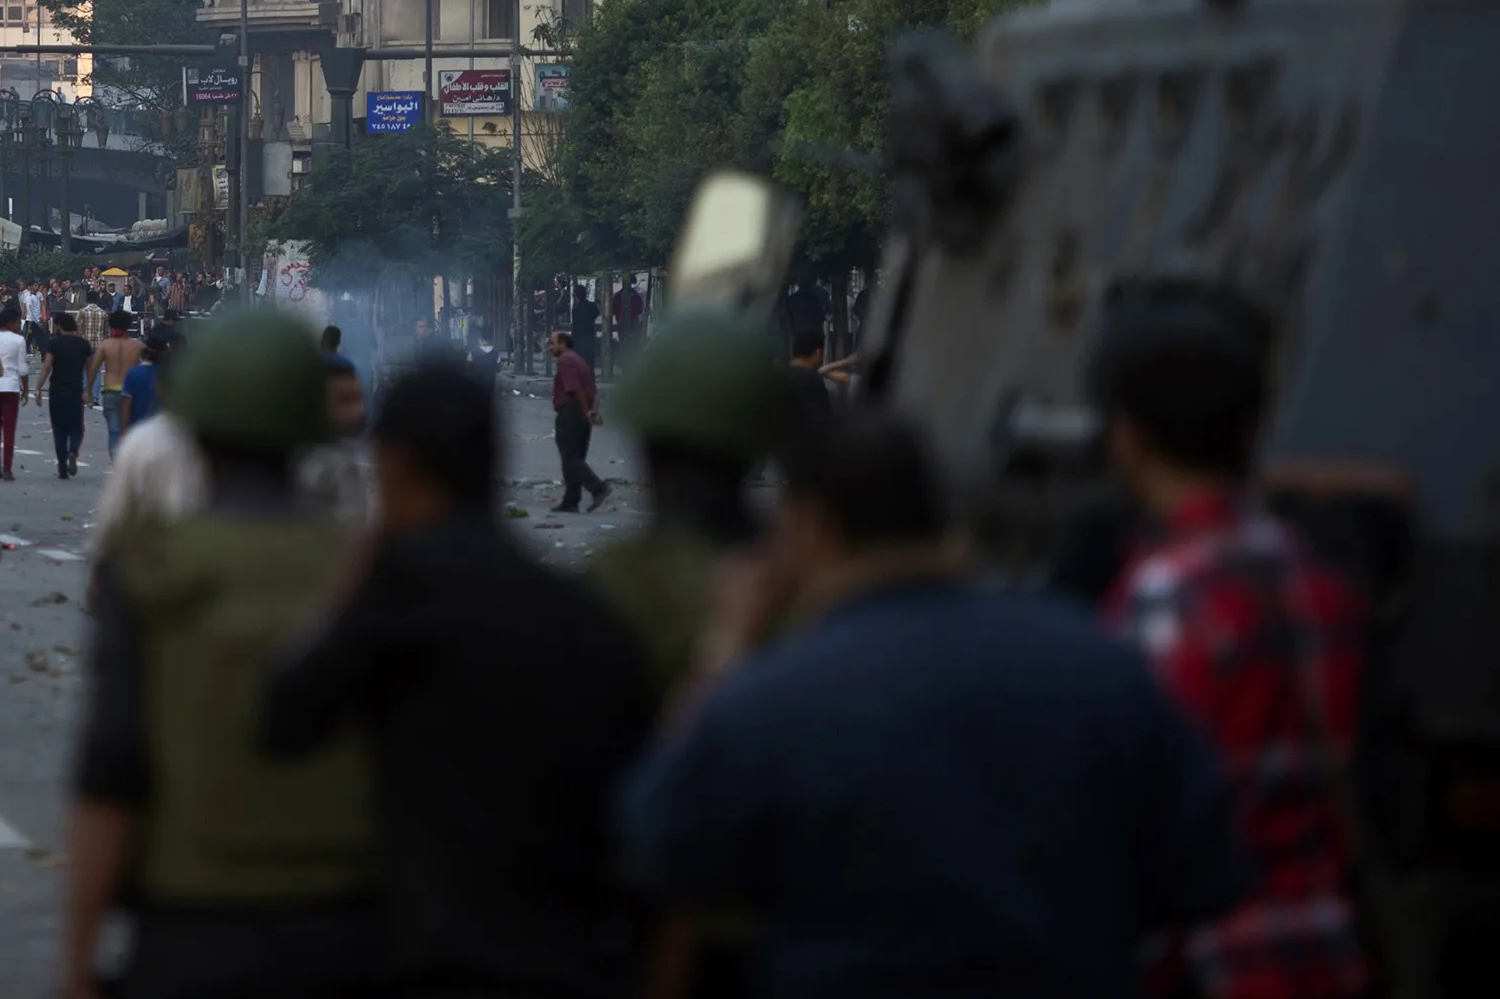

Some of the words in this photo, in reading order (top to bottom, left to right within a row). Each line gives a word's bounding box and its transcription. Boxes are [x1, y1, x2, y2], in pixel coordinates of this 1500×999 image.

[201, 75, 214, 85] لاب
[214, 75, 237, 85] رويال
[469, 82, 489, 94] وقلب
[490, 82, 508, 91] القلب
[372, 102, 418, 114] البواسير
